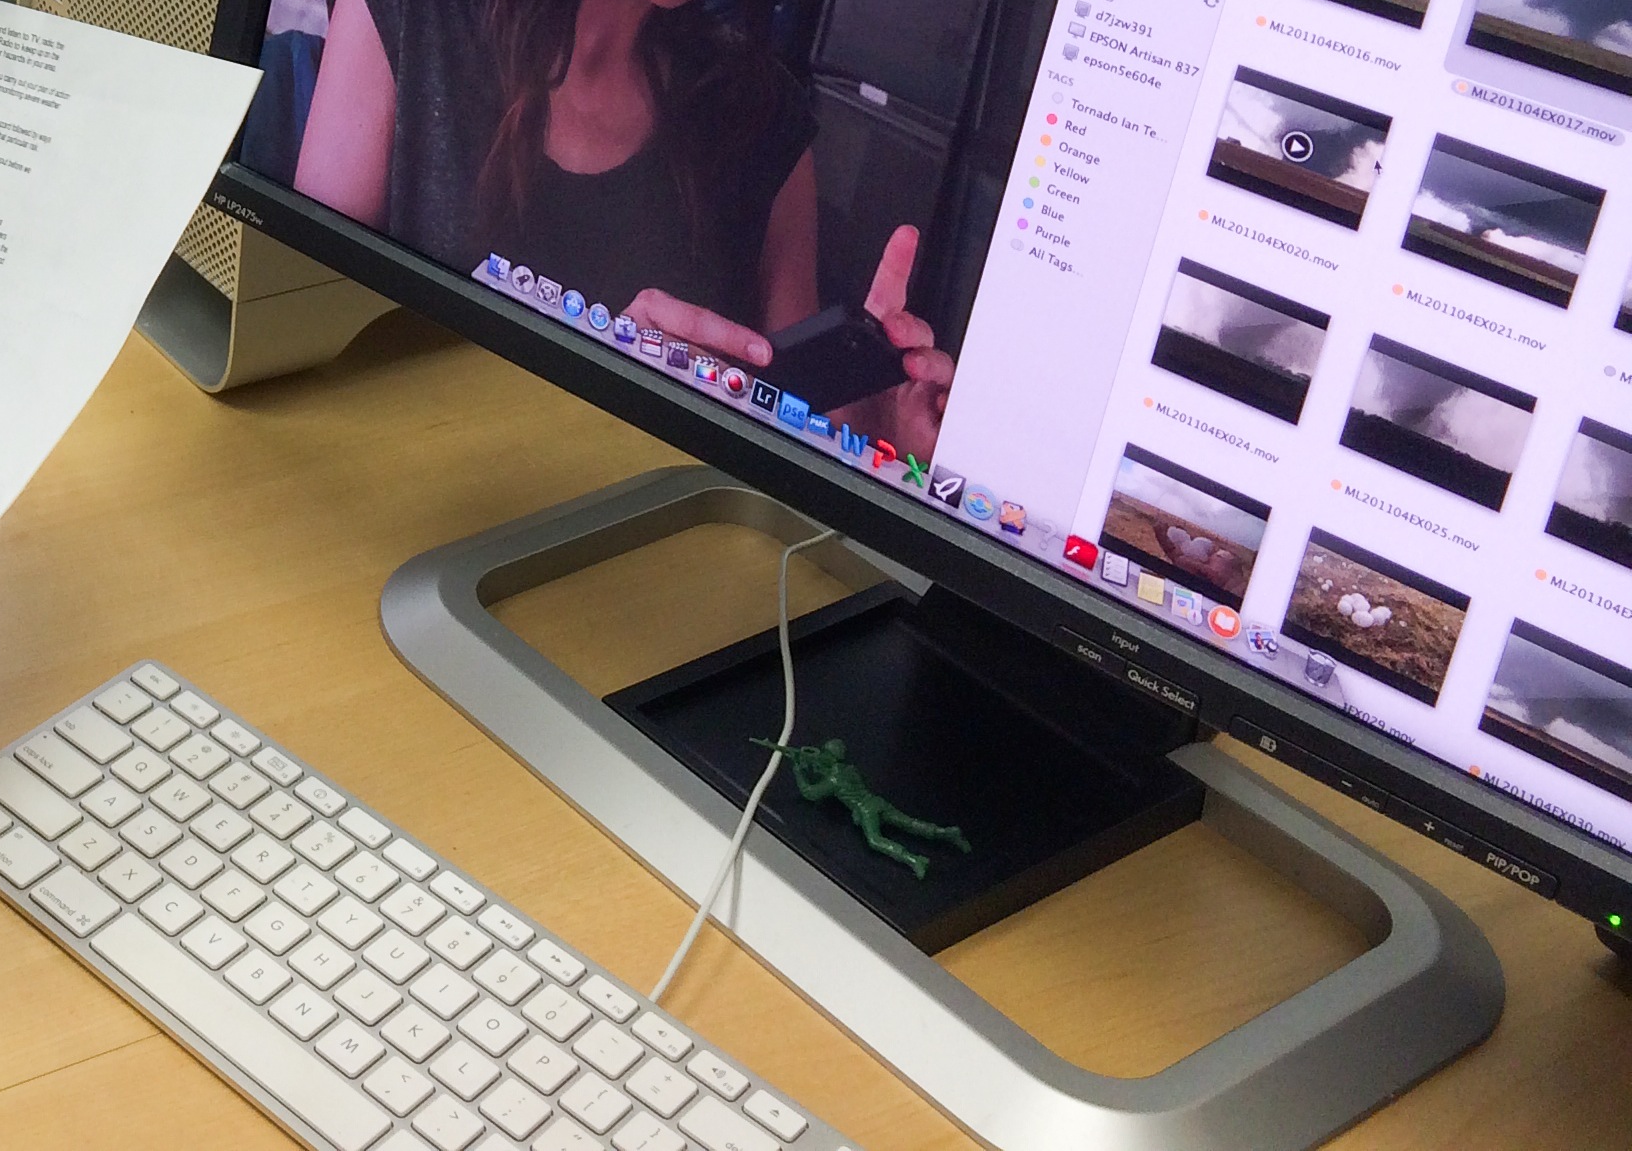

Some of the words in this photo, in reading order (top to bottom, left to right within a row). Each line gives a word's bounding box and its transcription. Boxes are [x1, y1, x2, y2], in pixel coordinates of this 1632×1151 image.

[1096, 11, 1153, 38] d7jzw391
[1090, 31, 1128, 53] EPSON
[1130, 46, 1172, 68] Artisan
[1175, 61, 1200, 77] 837
[1269, 20, 1401, 73] ML201104EX016.mov
[1047, 70, 1075, 86] TAGS
[1083, 54, 1162, 89] epson5e604e
[1065, 120, 1087, 136] Red
[1071, 98, 1118, 124] Tornado
[1121, 117, 1139, 132] Ian
[1471, 85, 1616, 144] ML201104EX017.mov
[1059, 142, 1101, 166] Orange
[1053, 162, 1090, 185] Yellow
[1047, 184, 1081, 205] Green
[1041, 205, 1065, 222] Blue
[1035, 225, 1071, 248] Purple
[1211, 214, 1339, 272] ML201104EX020.mov
[1029, 247, 1044, 261] All
[1406, 288, 1547, 352] ML201104EX021.mov
[757, 386, 771, 406] Lr
[783, 402, 804, 421] pse
[873, 438, 897, 468] P
[1156, 401, 1280, 465] ML201104EX024.mov
[1344, 485, 1480, 552] ML201104EX025.mov
[1077, 644, 1102, 664] scan
[1111, 632, 1140, 653] input
[1128, 669, 1160, 694] Quick
[1162, 687, 1195, 710] Select
[23, 745, 39, 761] caps
[39, 757, 53, 770] lock
[135, 761, 148, 773] Q
[173, 788, 190, 802] W
[215, 819, 229, 830] E
[256, 850, 269, 862] R
[301, 881, 314, 892] T
[103, 797, 117, 807] A
[144, 825, 157, 835] S
[184, 855, 198, 866] D
[227, 887, 240, 897] F
[270, 920, 284, 931] G
[1486, 851, 1541, 886] PIP/POP
[38, 885, 77, 917] command
[83, 837, 97, 849] Z
[122, 868, 138, 880] X
[164, 901, 179, 912] C
[208, 933, 222, 945] V
